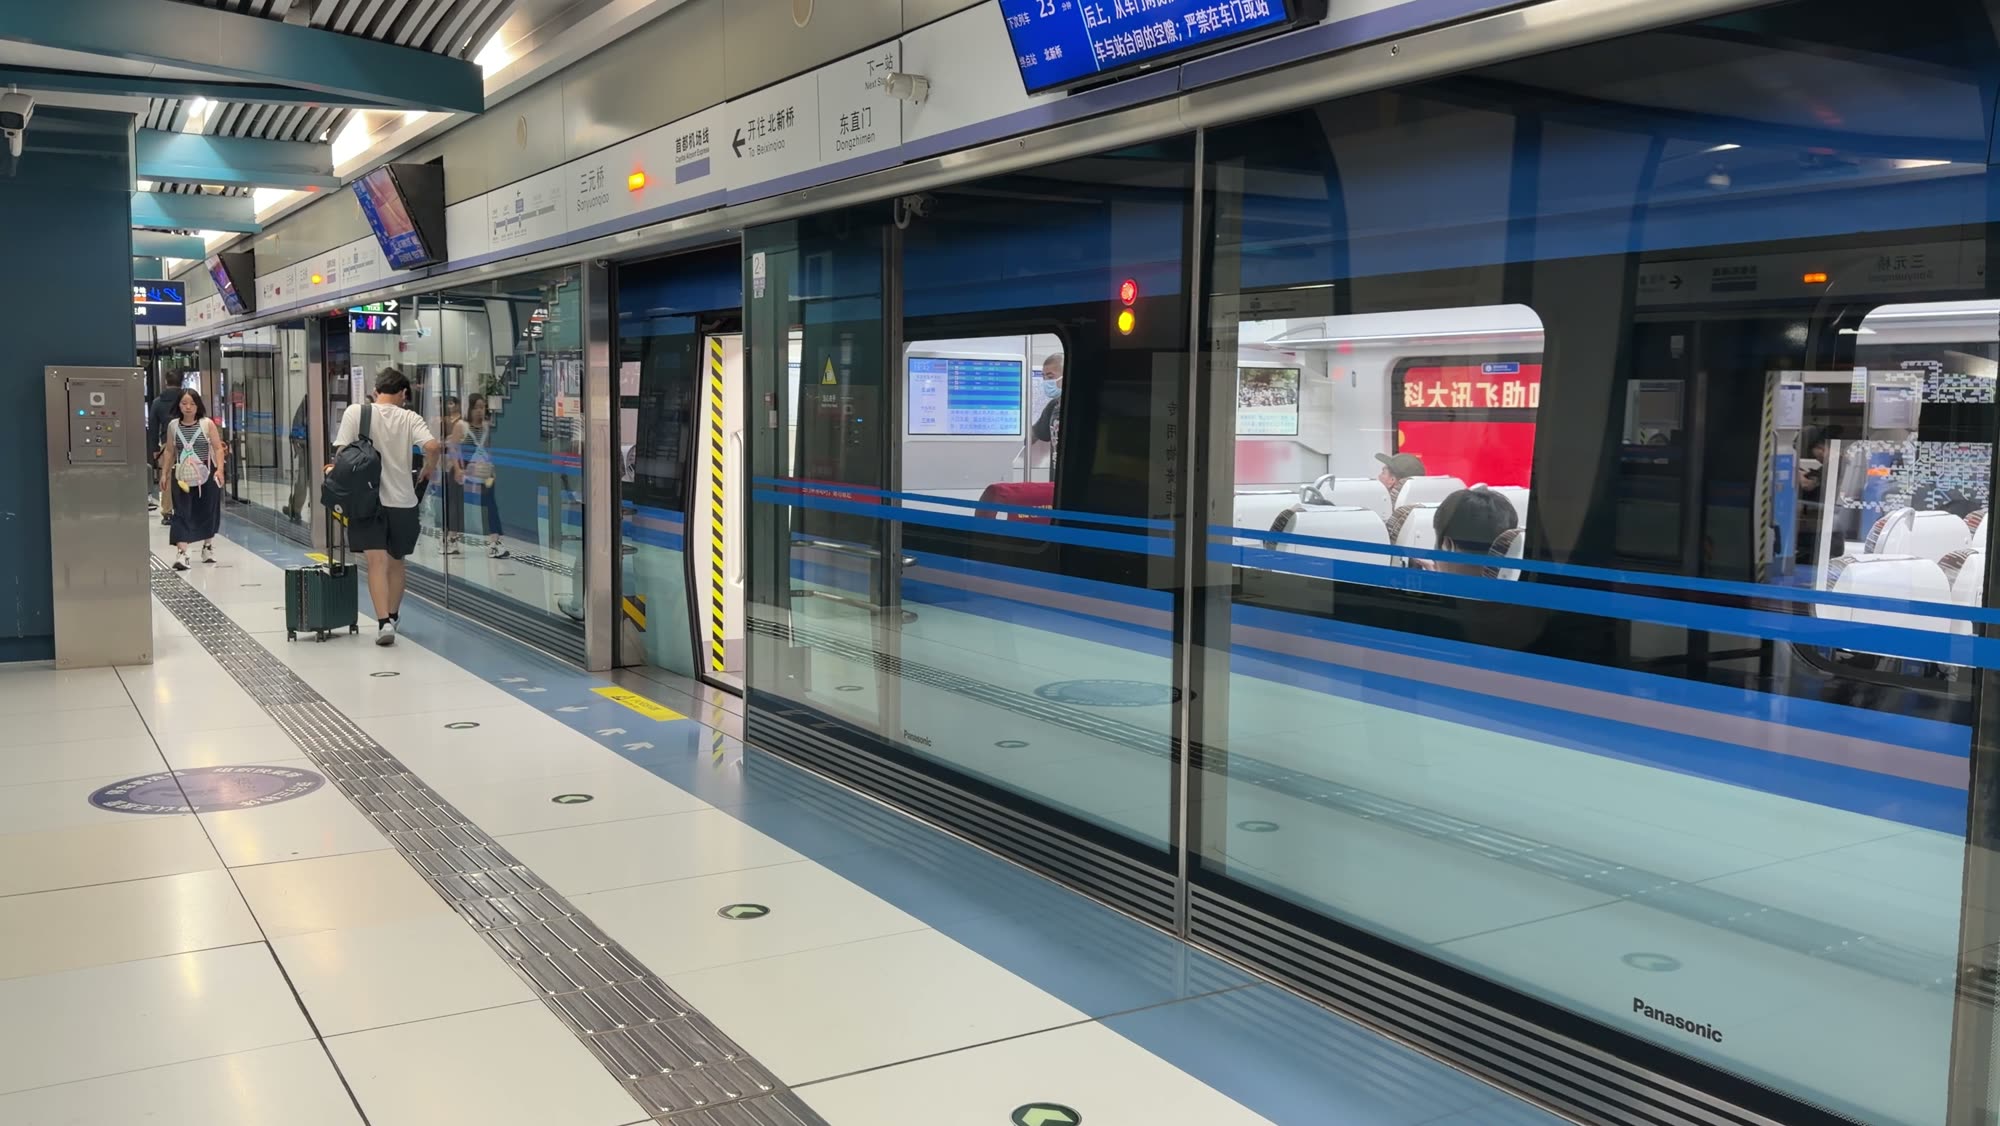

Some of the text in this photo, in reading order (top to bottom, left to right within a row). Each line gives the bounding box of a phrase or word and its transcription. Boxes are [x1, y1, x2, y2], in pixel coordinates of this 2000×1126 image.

[1036, 0, 1056, 18] 23
[1006, 12, 1031, 29] 下次列车
[1019, 53, 1038, 68] 终点站
[1044, 45, 1063, 61] 北新桥
[867, 53, 893, 77] 下一站
[748, 106, 795, 141] 开往 北新桥
[840, 107, 872, 135] 东直门
[675, 127, 709, 153] 首都机场线
[757, 138, 786, 156] Beixinqiao
[836, 133, 876, 152] Dongzhimen
[580, 165, 605, 193] 三元桥
[903, 729, 932, 747] Panasonic
[1633, 997, 1723, 1043] Panasonic
